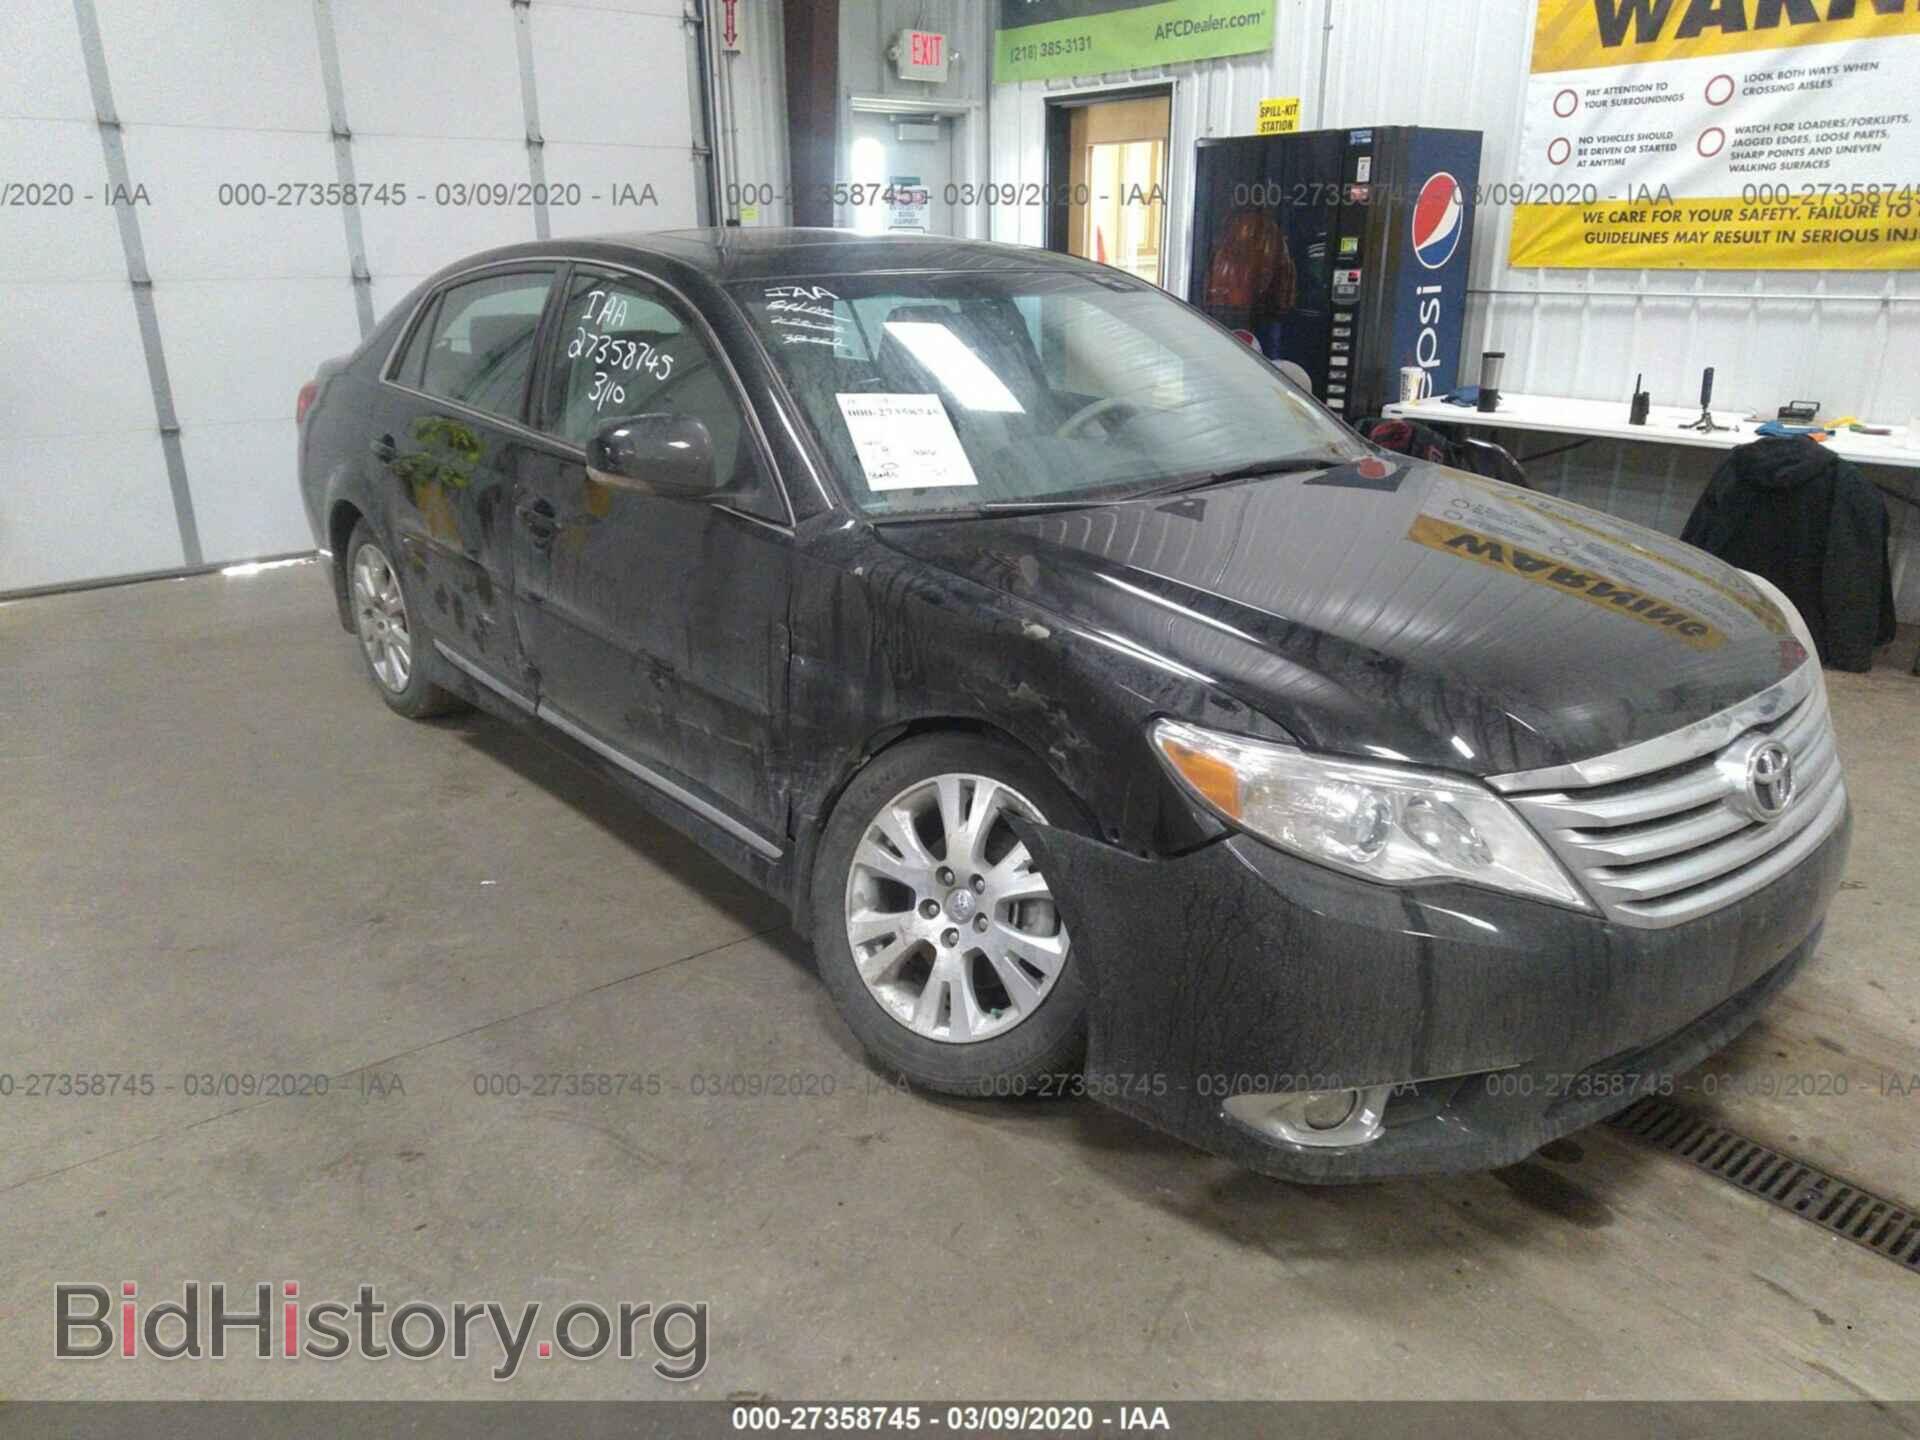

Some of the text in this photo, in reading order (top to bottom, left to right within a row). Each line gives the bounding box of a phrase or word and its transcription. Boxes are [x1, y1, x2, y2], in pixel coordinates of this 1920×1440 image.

[1594, 0, 1920, 48] WA
[911, 32, 944, 66] EXIT
[1744, 61, 1880, 83] LOOK BOTH WAYS WHEN
[1603, 84, 1654, 95] ATTENTION
[1656, 82, 1668, 91] TO
[1742, 79, 1833, 96] CROSSING AISLES
[1584, 93, 1684, 109] YOUR SURROUNDINGS
[1260, 103, 1297, 118] SPILL-KIT
[1261, 119, 1293, 132] STATION
[1735, 124, 1770, 134] WATCH
[1774, 122, 1794, 132] FOR
[1578, 131, 1673, 144] NO VEHICLES SHOULD
[1731, 137, 1773, 147] JAGGED
[1815, 132, 1850, 143] LOOSE
[1577, 143, 1677, 156] BE DRIVEN OR STARTED
[1730, 144, 1882, 160] SHARP POINTS AND UNEVEN
[1589, 158, 1626, 167] ANYTIME
[1728, 159, 1831, 173] WALKING SURFACES
[1583, 203, 1911, 223] WE CARE FOR YOUR SAFETY. FAILURE TO
[1584, 227, 1920, 244] GUIDELINES MAY RESULT IN SERIOUS INJ
[582, 290, 627, 327] IAA
[568, 326, 674, 380] 27358745
[588, 372, 625, 412] 3/10
